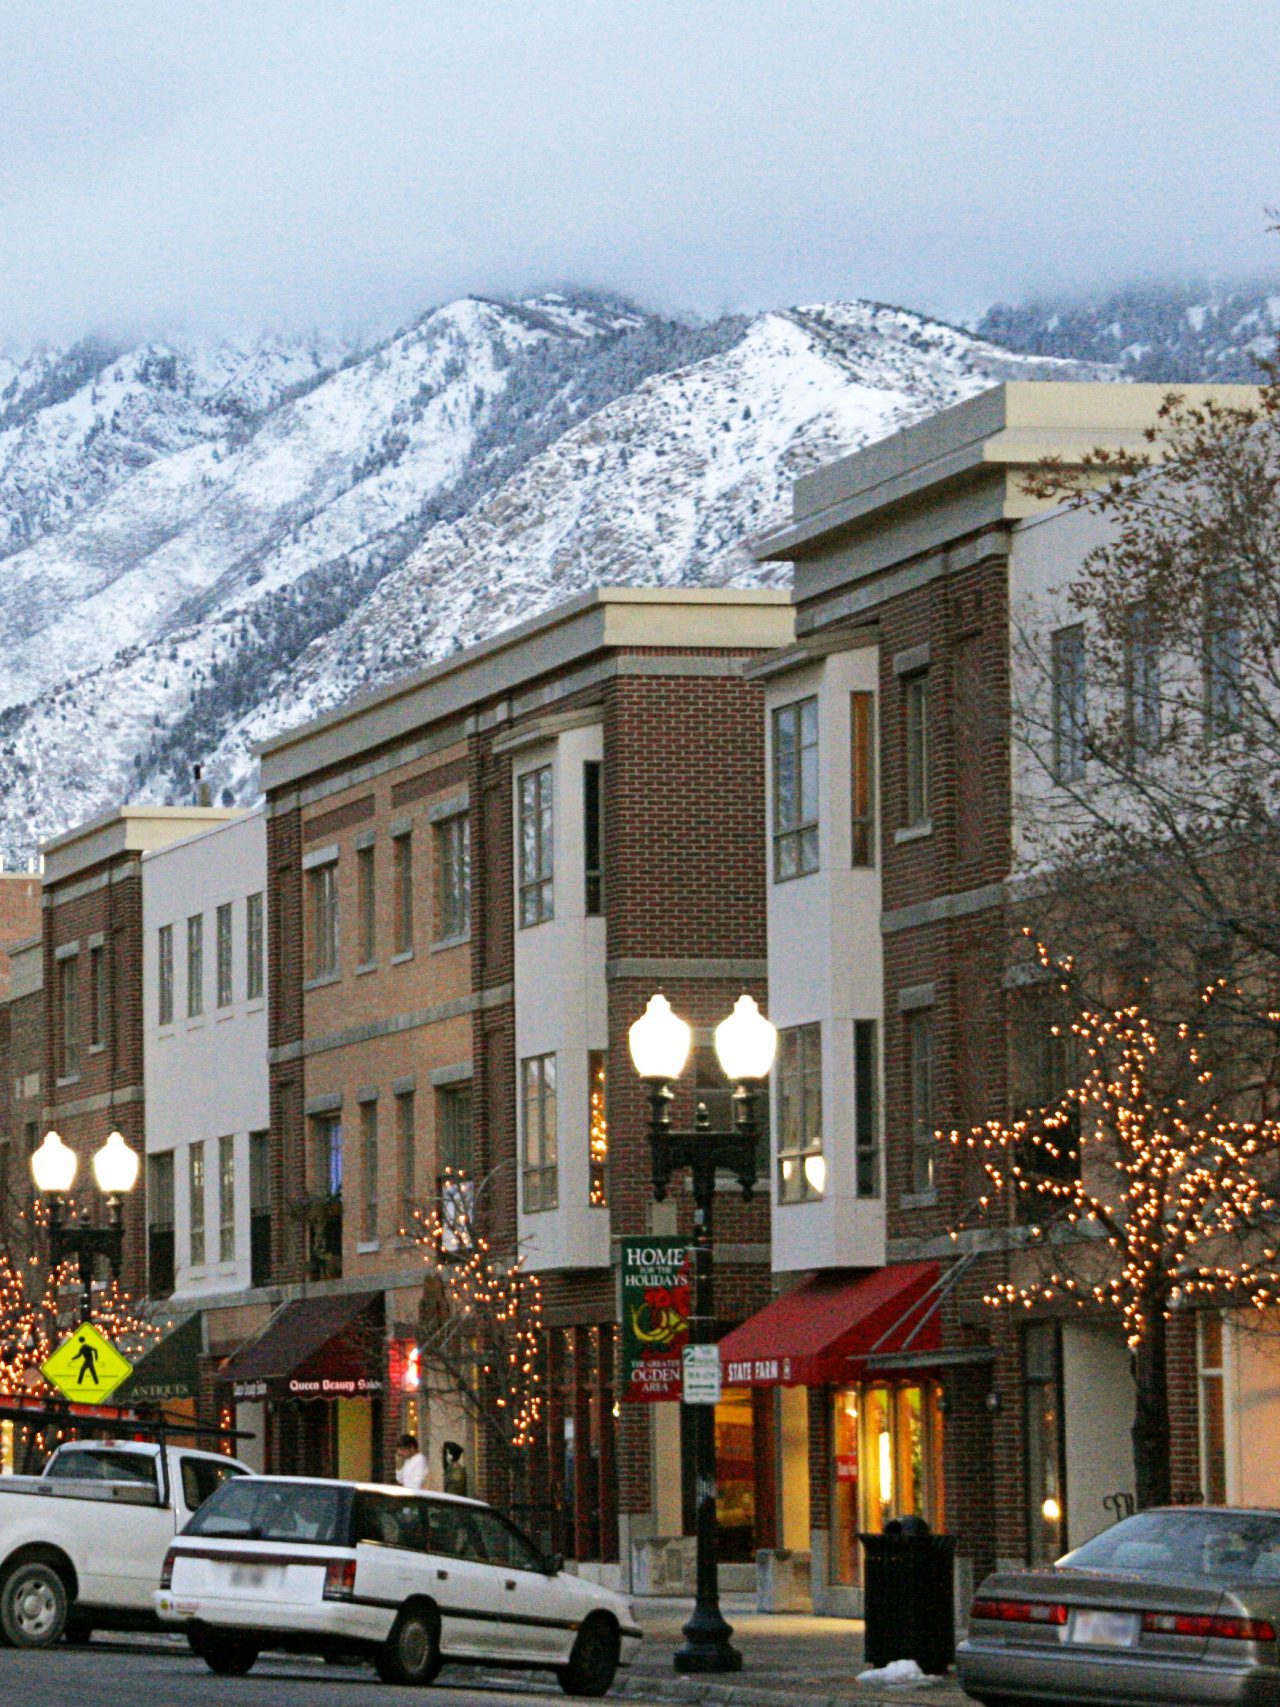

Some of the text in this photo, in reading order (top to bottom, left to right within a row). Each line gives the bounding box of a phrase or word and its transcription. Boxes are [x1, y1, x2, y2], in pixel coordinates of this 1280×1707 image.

[626, 1248, 685, 1266] HOME
[625, 1274, 688, 1287] HOLIDAYS
[631, 1368, 680, 1382] OGDEN
[728, 1362, 752, 1381] STATE
[755, 1360, 778, 1379] FARM
[131, 1384, 189, 1397] ANTIQUES
[289, 1379, 320, 1391] Queen
[322, 1379, 355, 1392] Beauty
[641, 1382, 669, 1393] AREA
